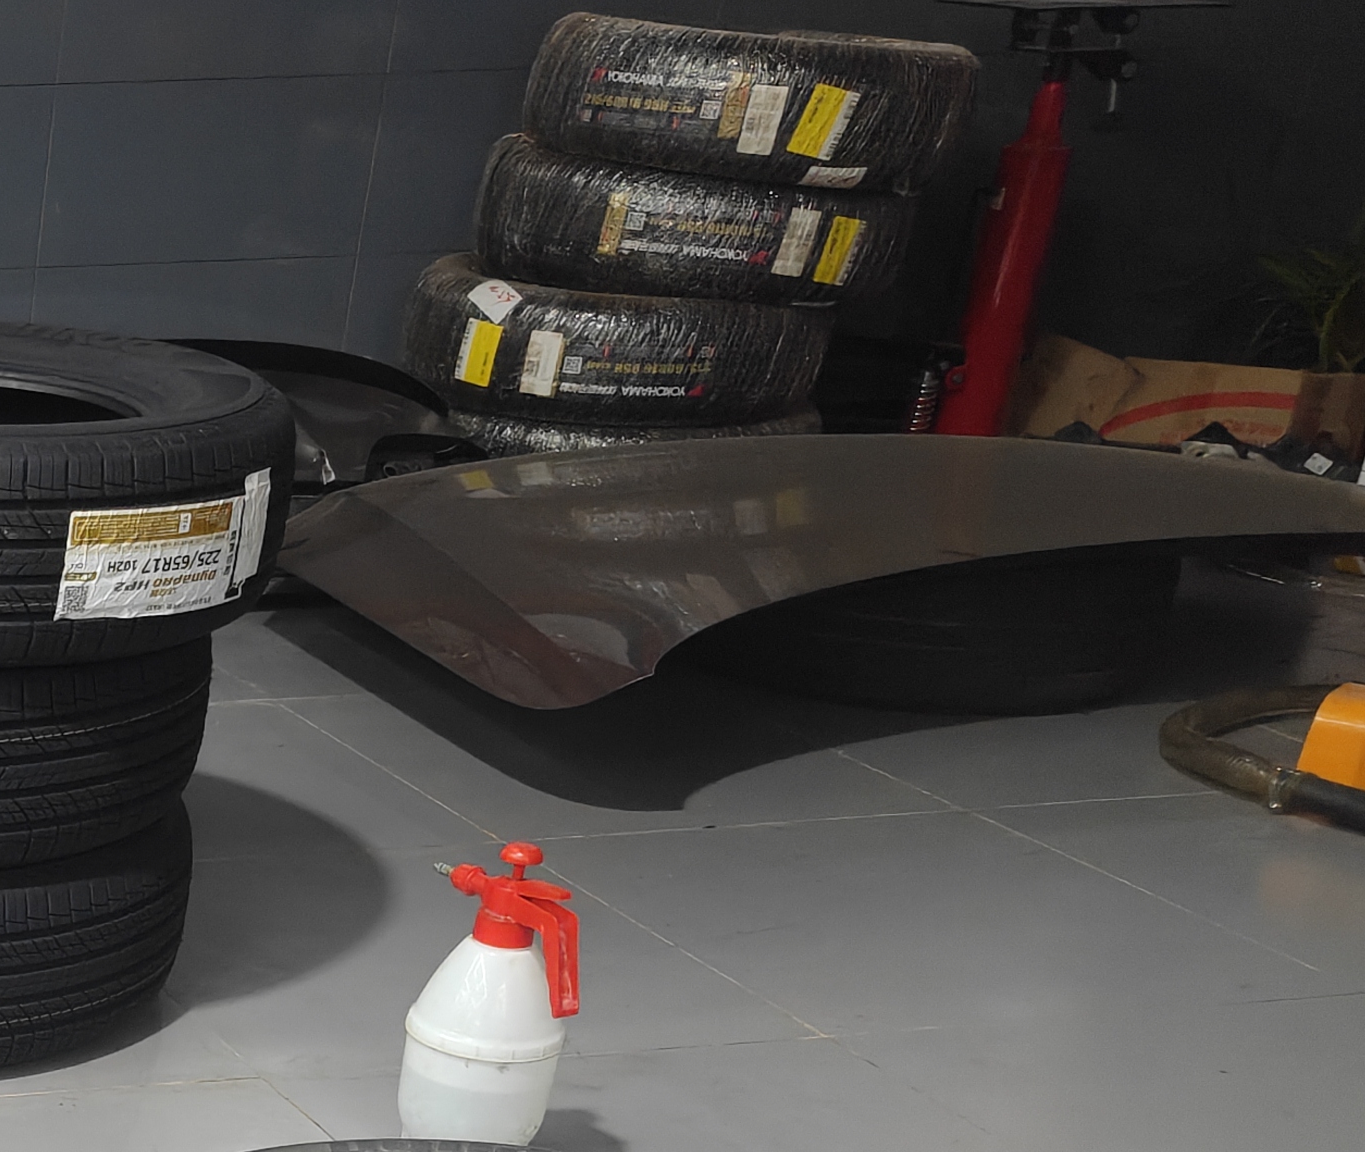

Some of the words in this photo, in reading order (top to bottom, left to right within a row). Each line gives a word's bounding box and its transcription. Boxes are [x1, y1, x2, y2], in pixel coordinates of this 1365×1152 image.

[607, 70, 664, 87] YOKOHAMA
[682, 244, 748, 261] YOKOHAMA
[621, 385, 686, 397] YOKOHAMA
[107, 558, 138, 572] 102H
[142, 549, 221, 575] 225/65R17
[113, 579, 151, 593] HP2
